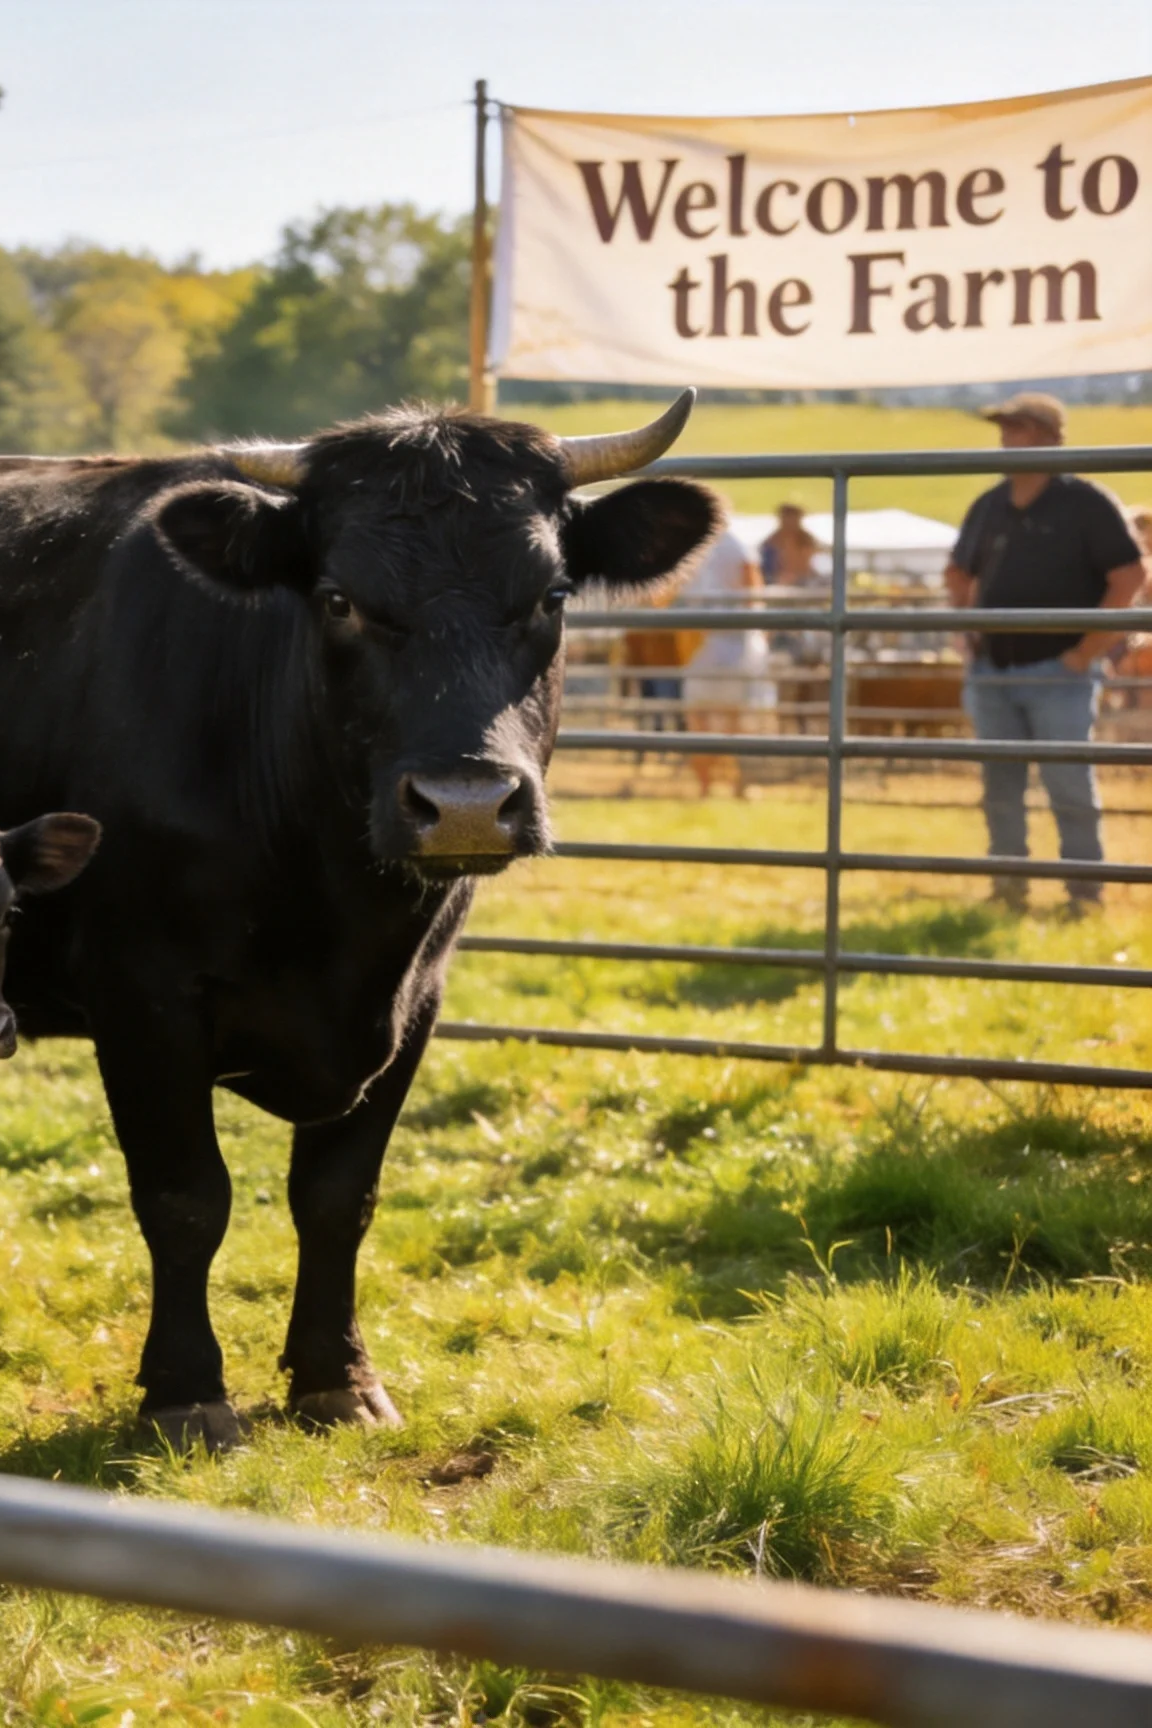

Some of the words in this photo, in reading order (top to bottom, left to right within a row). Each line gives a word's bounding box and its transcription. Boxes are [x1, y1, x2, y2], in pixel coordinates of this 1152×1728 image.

[575, 152, 1006, 244] Welcome
[1036, 143, 1139, 221] to
[668, 253, 813, 339] the
[847, 251, 1101, 334] Farm
